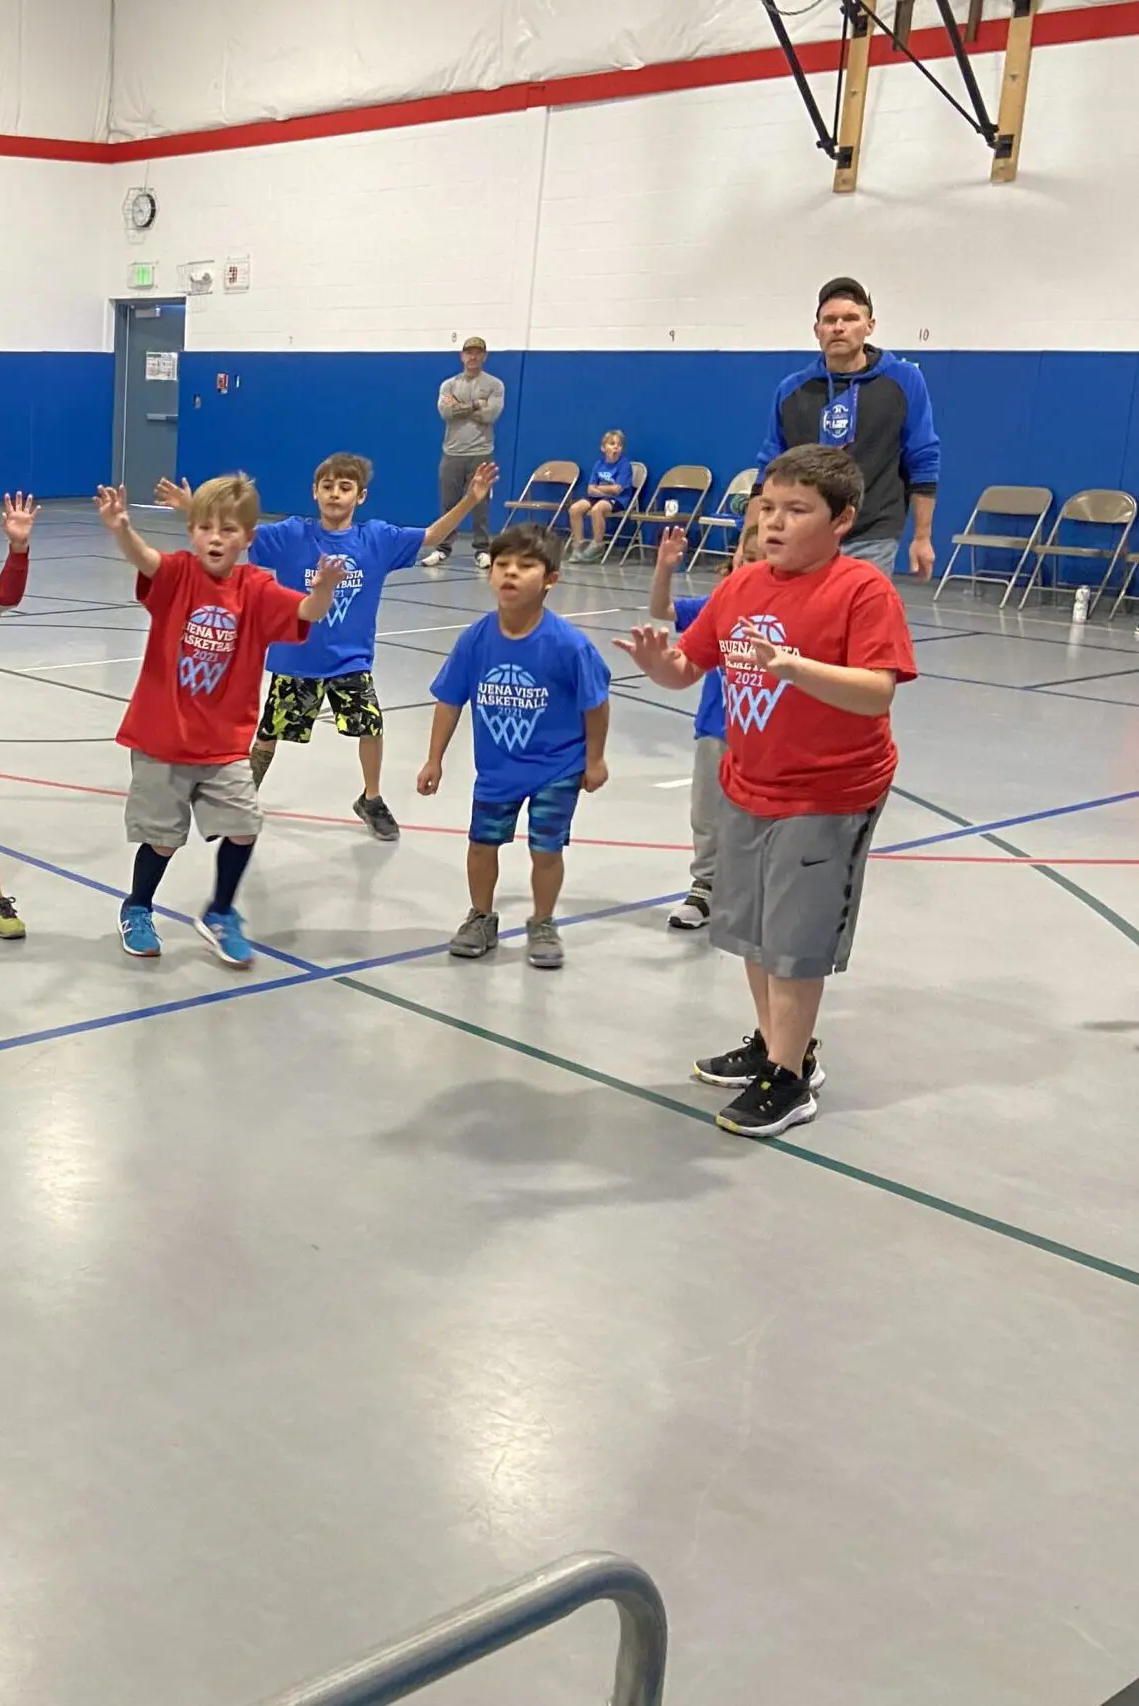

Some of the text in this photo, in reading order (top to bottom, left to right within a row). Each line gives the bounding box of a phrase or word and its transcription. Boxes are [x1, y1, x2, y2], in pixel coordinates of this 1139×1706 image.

[669, 330, 676, 342] 9
[919, 328, 930, 342] 10
[734, 671, 764, 687] 2021
[514, 686, 549, 699] VISTA
[498, 706, 522, 719] 2021
